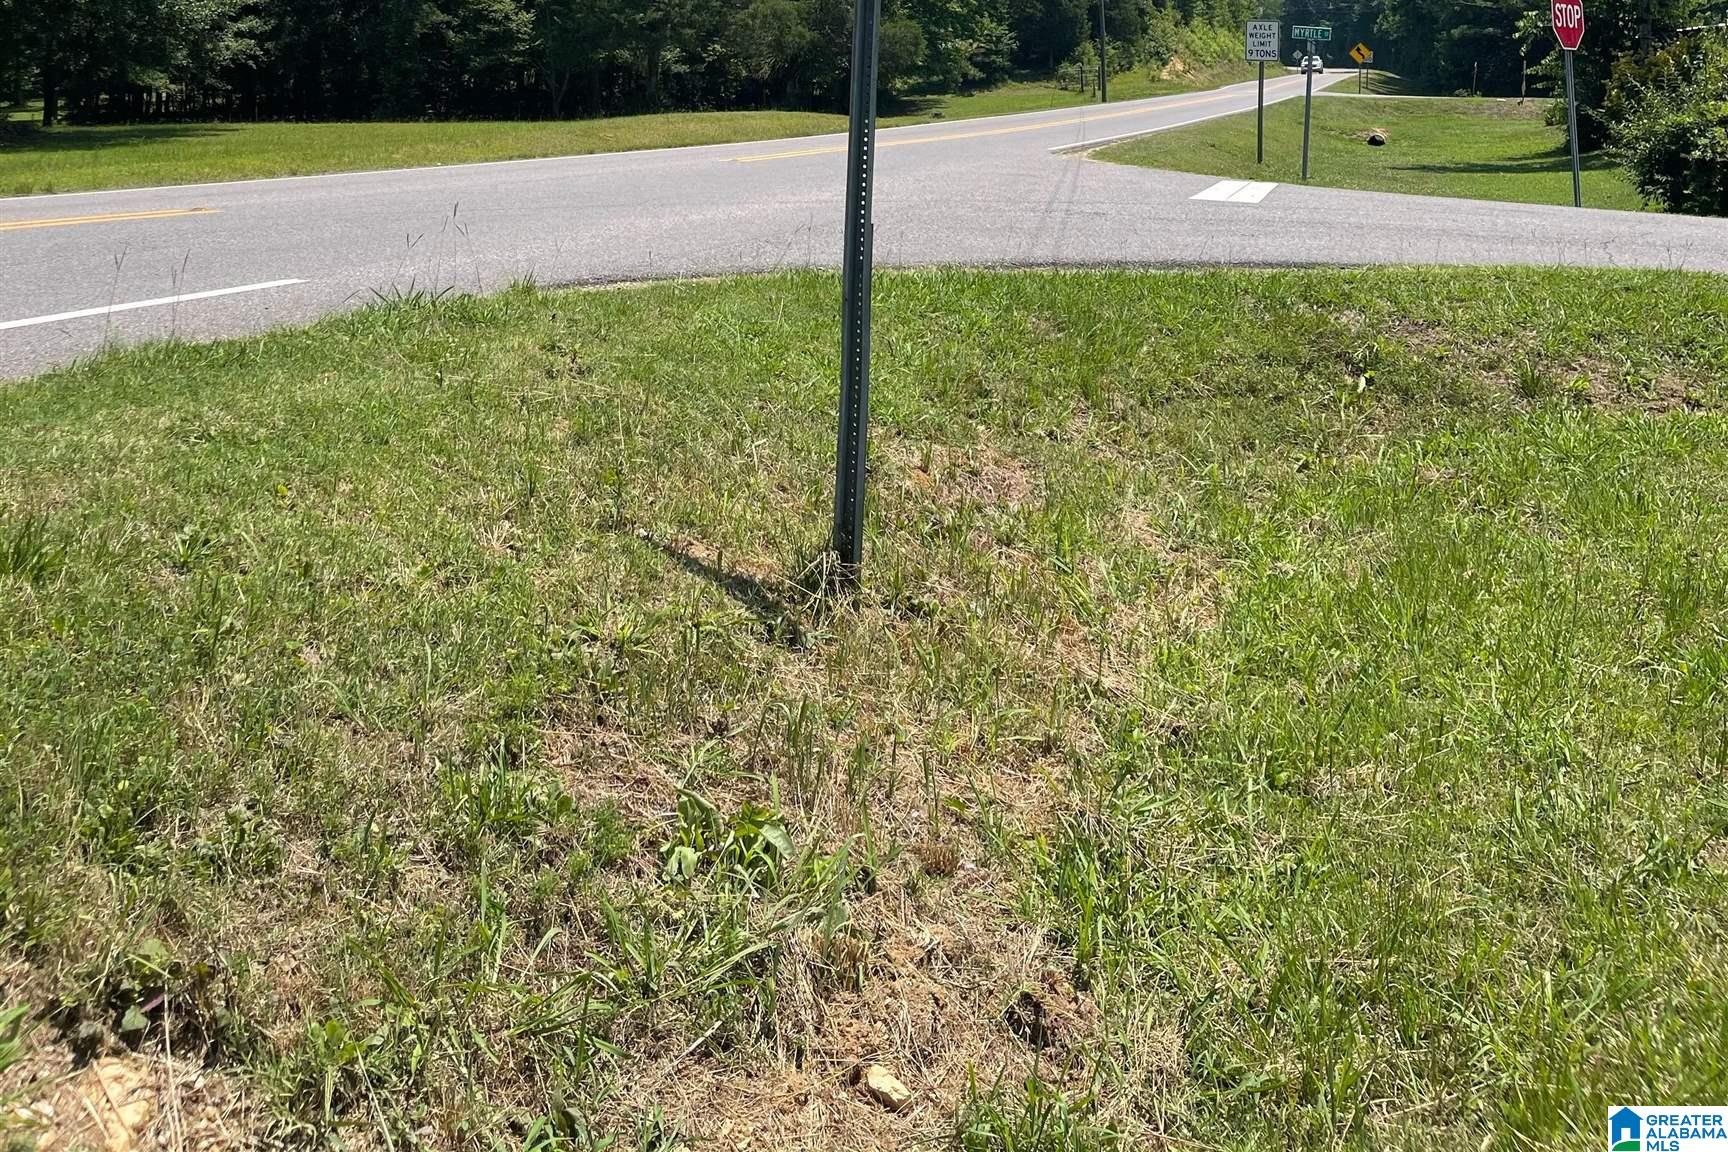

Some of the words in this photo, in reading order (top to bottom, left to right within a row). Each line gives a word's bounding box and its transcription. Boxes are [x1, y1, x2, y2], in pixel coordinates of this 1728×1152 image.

[1555, 3, 1581, 28] STOP
[1294, 28, 1323, 39] MYRTLE
[1247, 49, 1254, 57] 9
[1255, 49, 1277, 58] TONS
